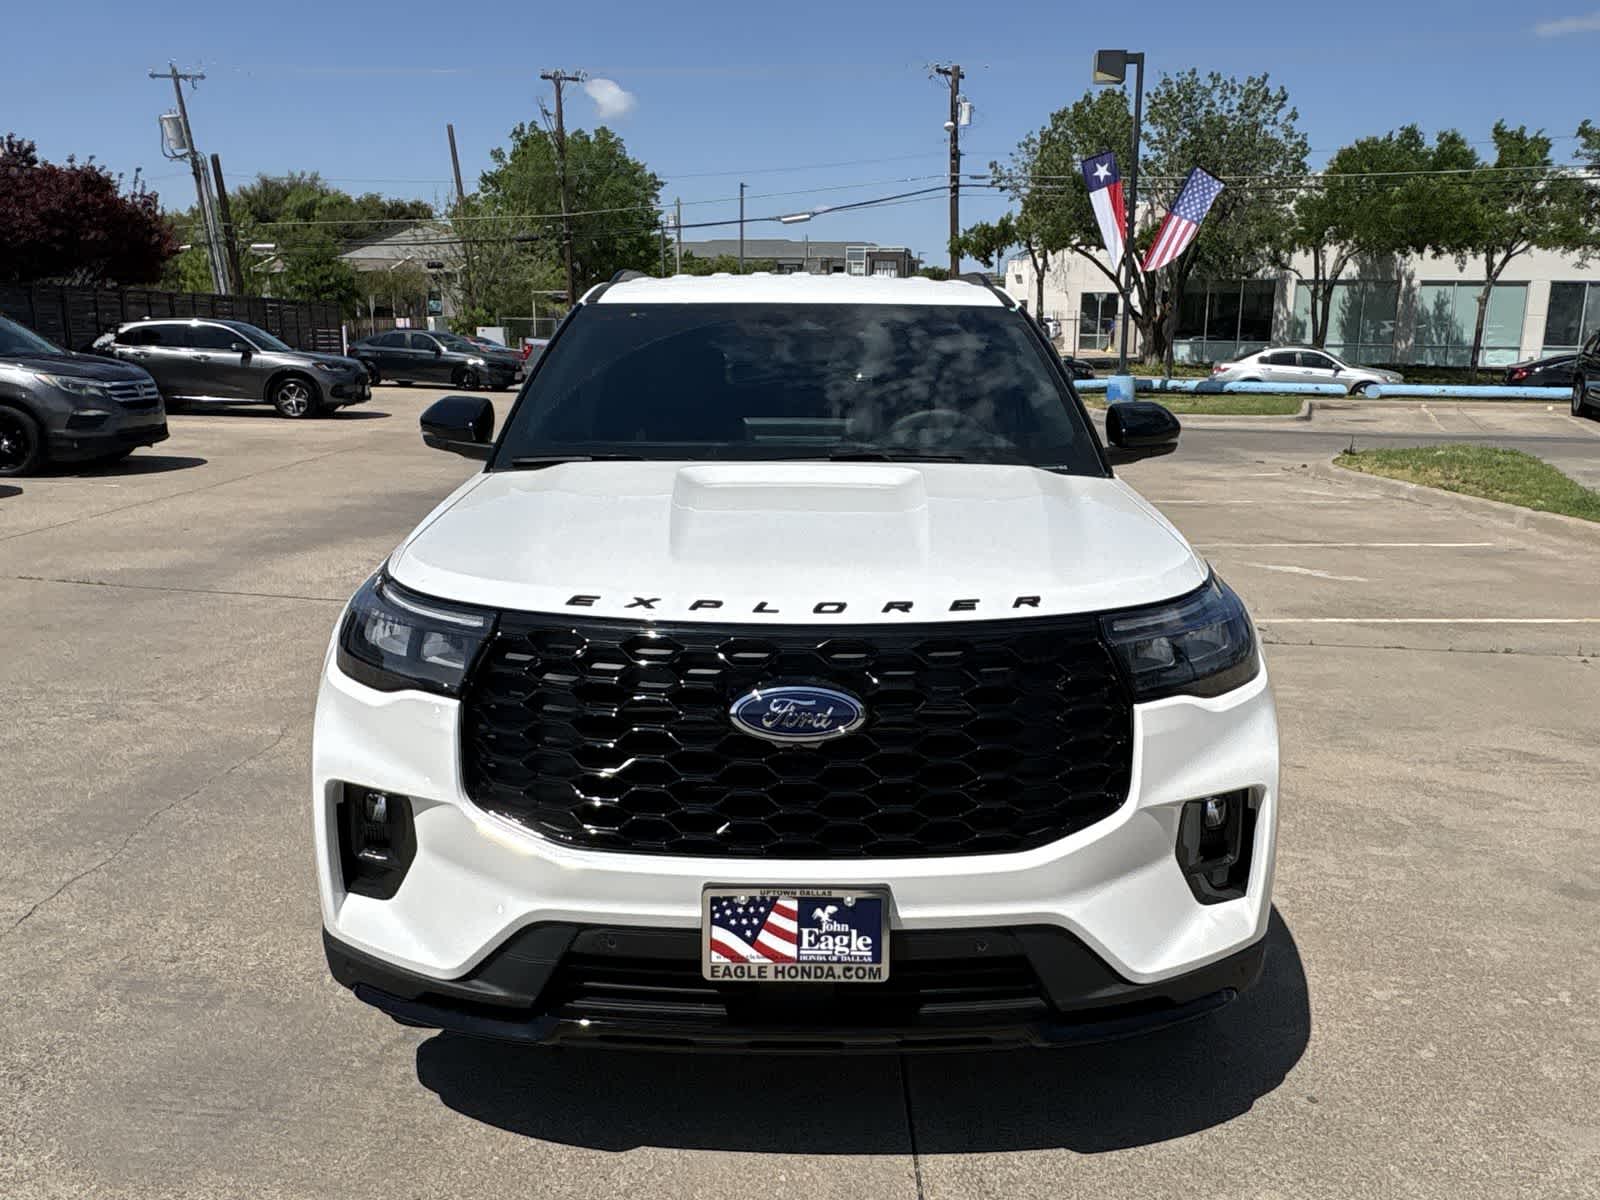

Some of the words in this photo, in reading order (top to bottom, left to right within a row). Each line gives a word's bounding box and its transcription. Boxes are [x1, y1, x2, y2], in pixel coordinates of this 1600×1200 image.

[566, 594, 1041, 614] EXPLORER
[762, 698, 834, 728] Ford
[800, 889, 832, 897] DALLAS
[821, 920, 849, 933] John
[800, 928, 872, 956] Eagle
[710, 966, 768, 979] EAGLE
[774, 966, 881, 980] HONDA.COM
